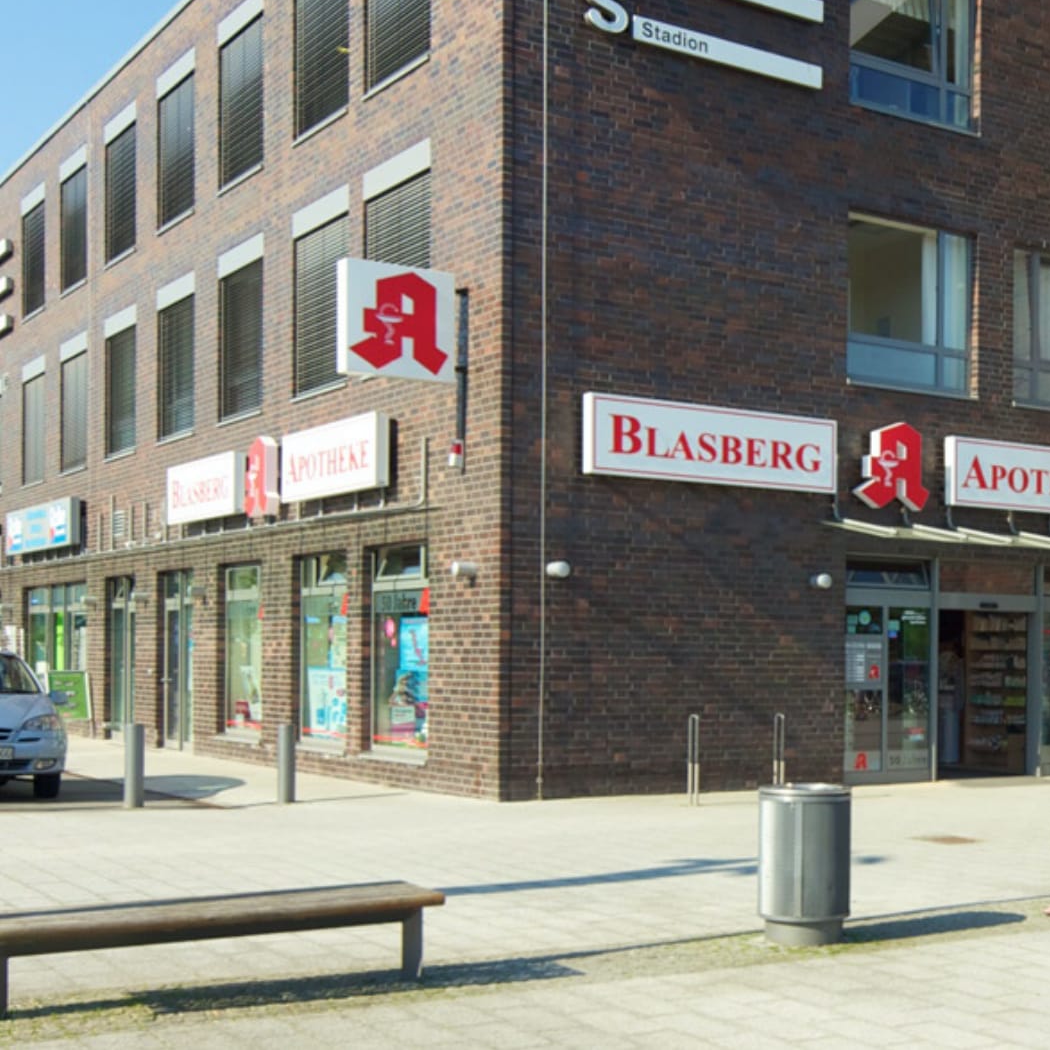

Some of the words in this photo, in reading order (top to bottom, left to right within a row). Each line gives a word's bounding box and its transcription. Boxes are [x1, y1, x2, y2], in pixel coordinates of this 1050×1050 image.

[641, 21, 709, 54] Stadion
[288, 439, 370, 485] APOTHEKE
[608, 413, 822, 474] BLASBERG
